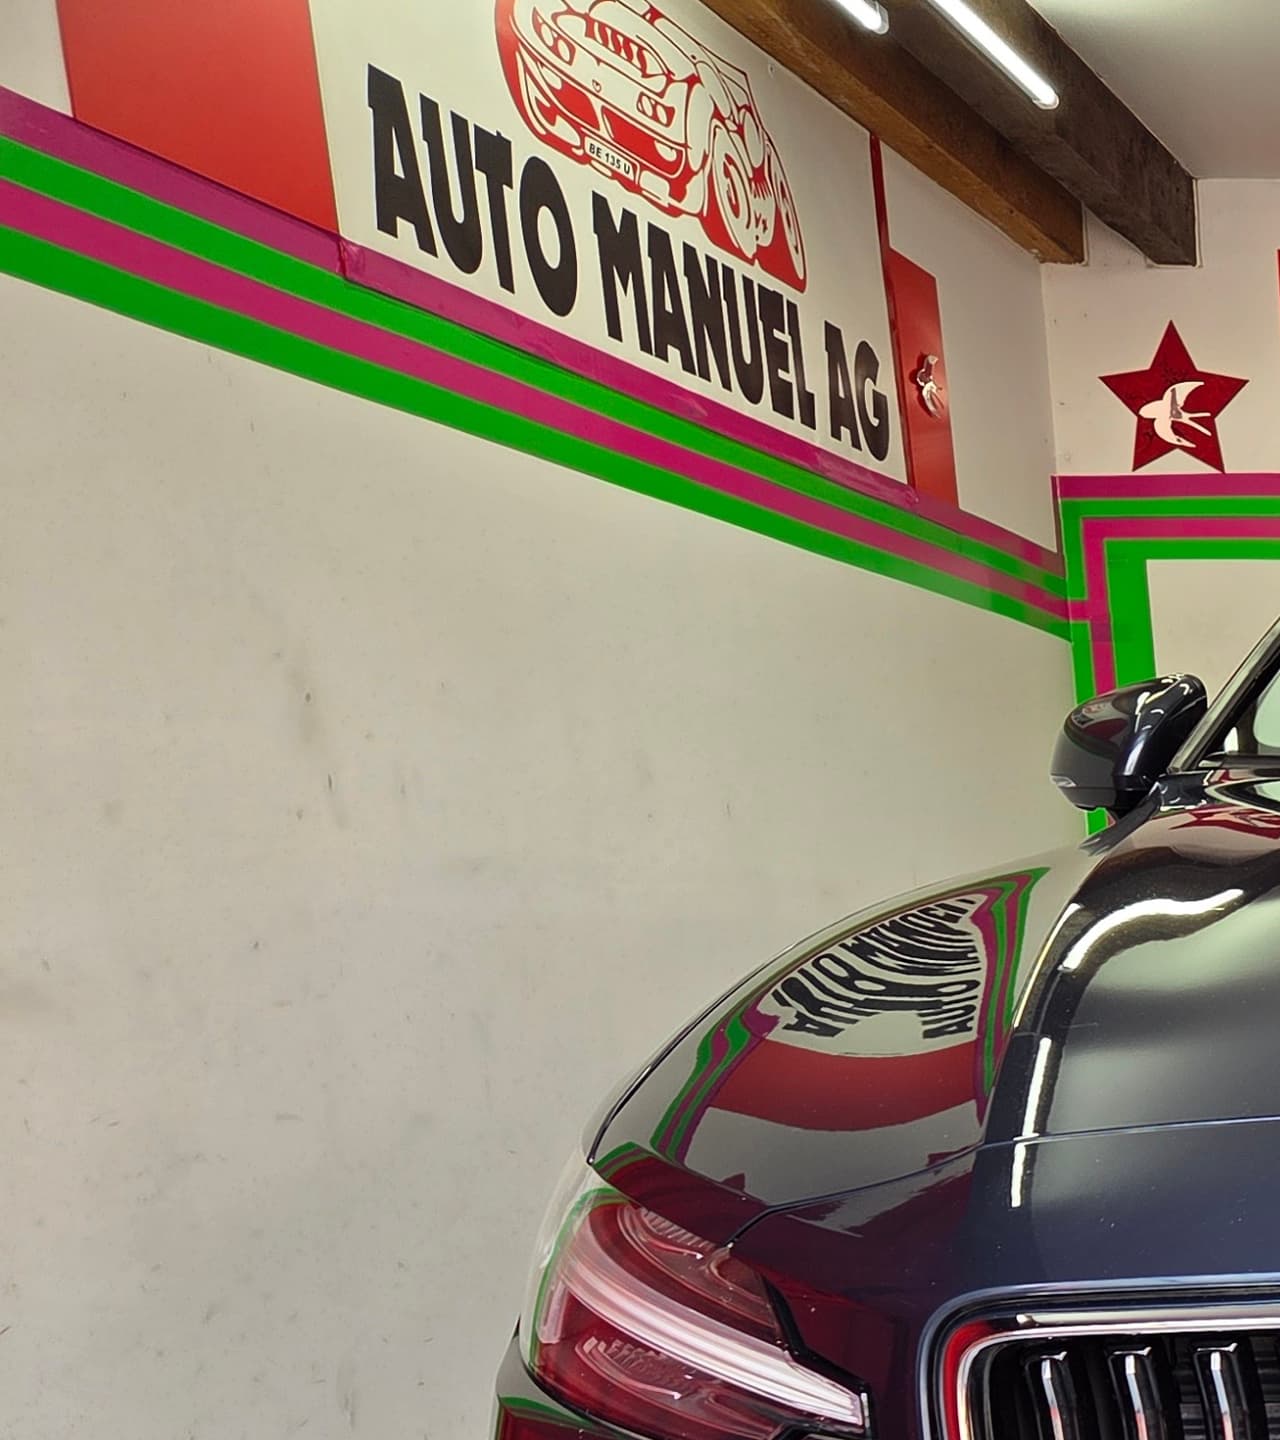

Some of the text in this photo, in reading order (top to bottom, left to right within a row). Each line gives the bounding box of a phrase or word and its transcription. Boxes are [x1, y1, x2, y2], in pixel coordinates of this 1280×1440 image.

[367, 63, 889, 462] AUTO MANUEL AG
[589, 143, 602, 158] BE
[623, 162, 631, 175] U
